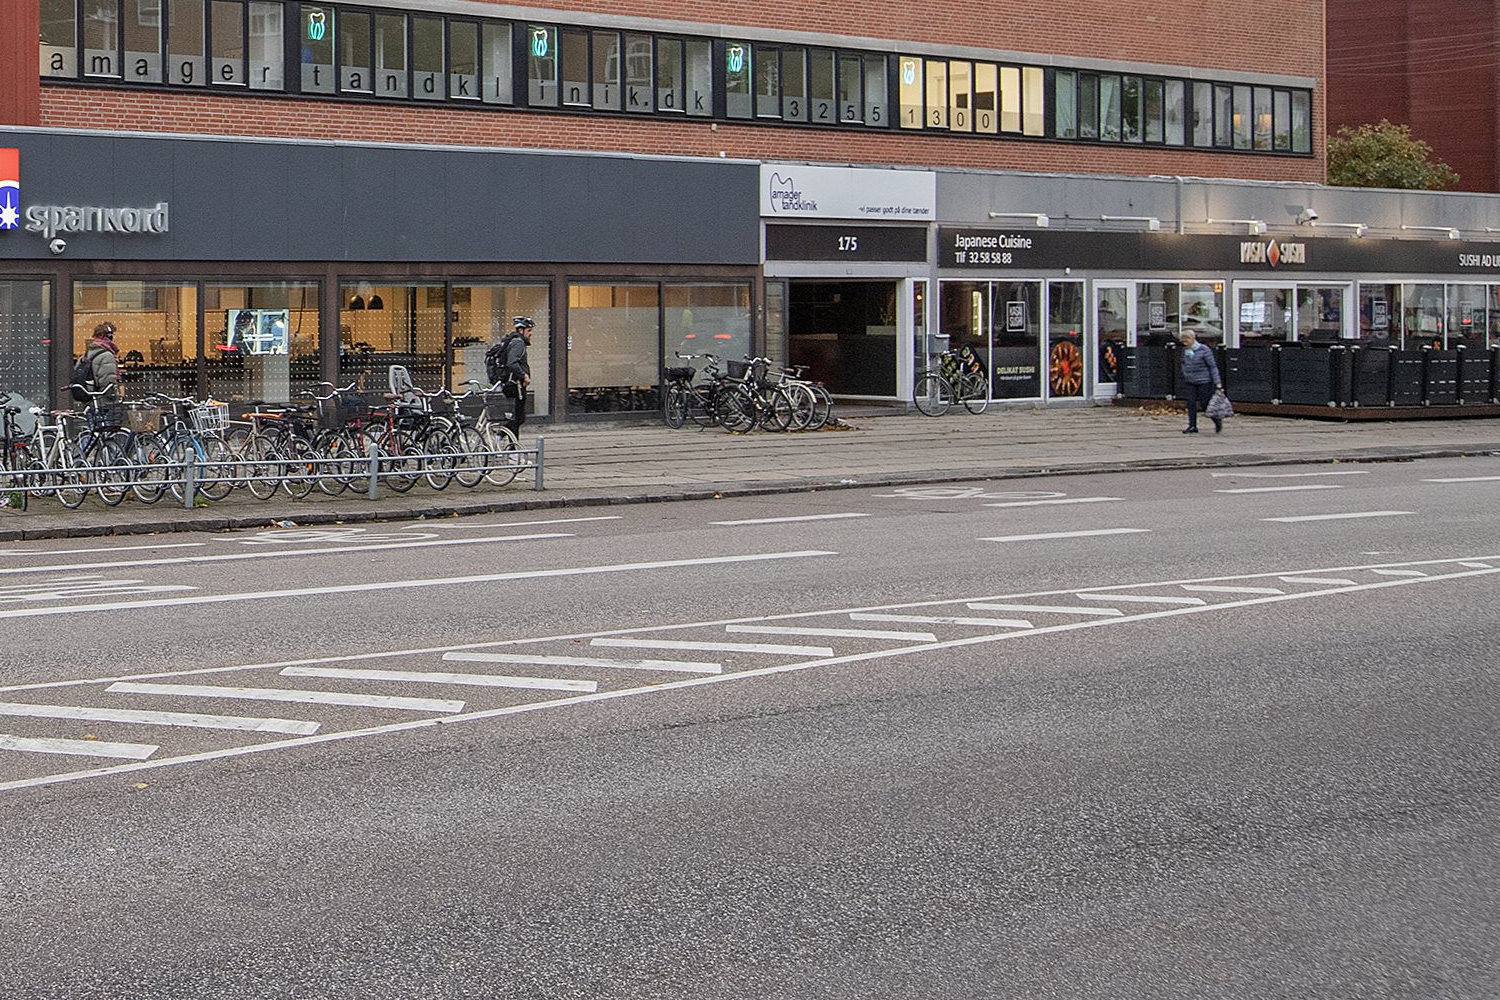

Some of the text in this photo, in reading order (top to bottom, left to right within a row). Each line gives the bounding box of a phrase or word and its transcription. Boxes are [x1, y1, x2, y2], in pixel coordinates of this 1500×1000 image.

[772, 190, 802, 202] amager
[782, 200, 818, 211] tandklinik
[866, 206, 882, 214] passer
[883, 206, 894, 215] godt
[901, 206, 912, 214] dine
[838, 236, 857, 251] 175
[955, 234, 1032, 250] Japanese Cuisine
[955, 251, 1012, 264] Tlf 32 58 58 88
[1459, 253, 1480, 267] SUSHI
[1481, 254, 1492, 267] AD
[996, 366, 1035, 375] DELIKAT SUSHI
